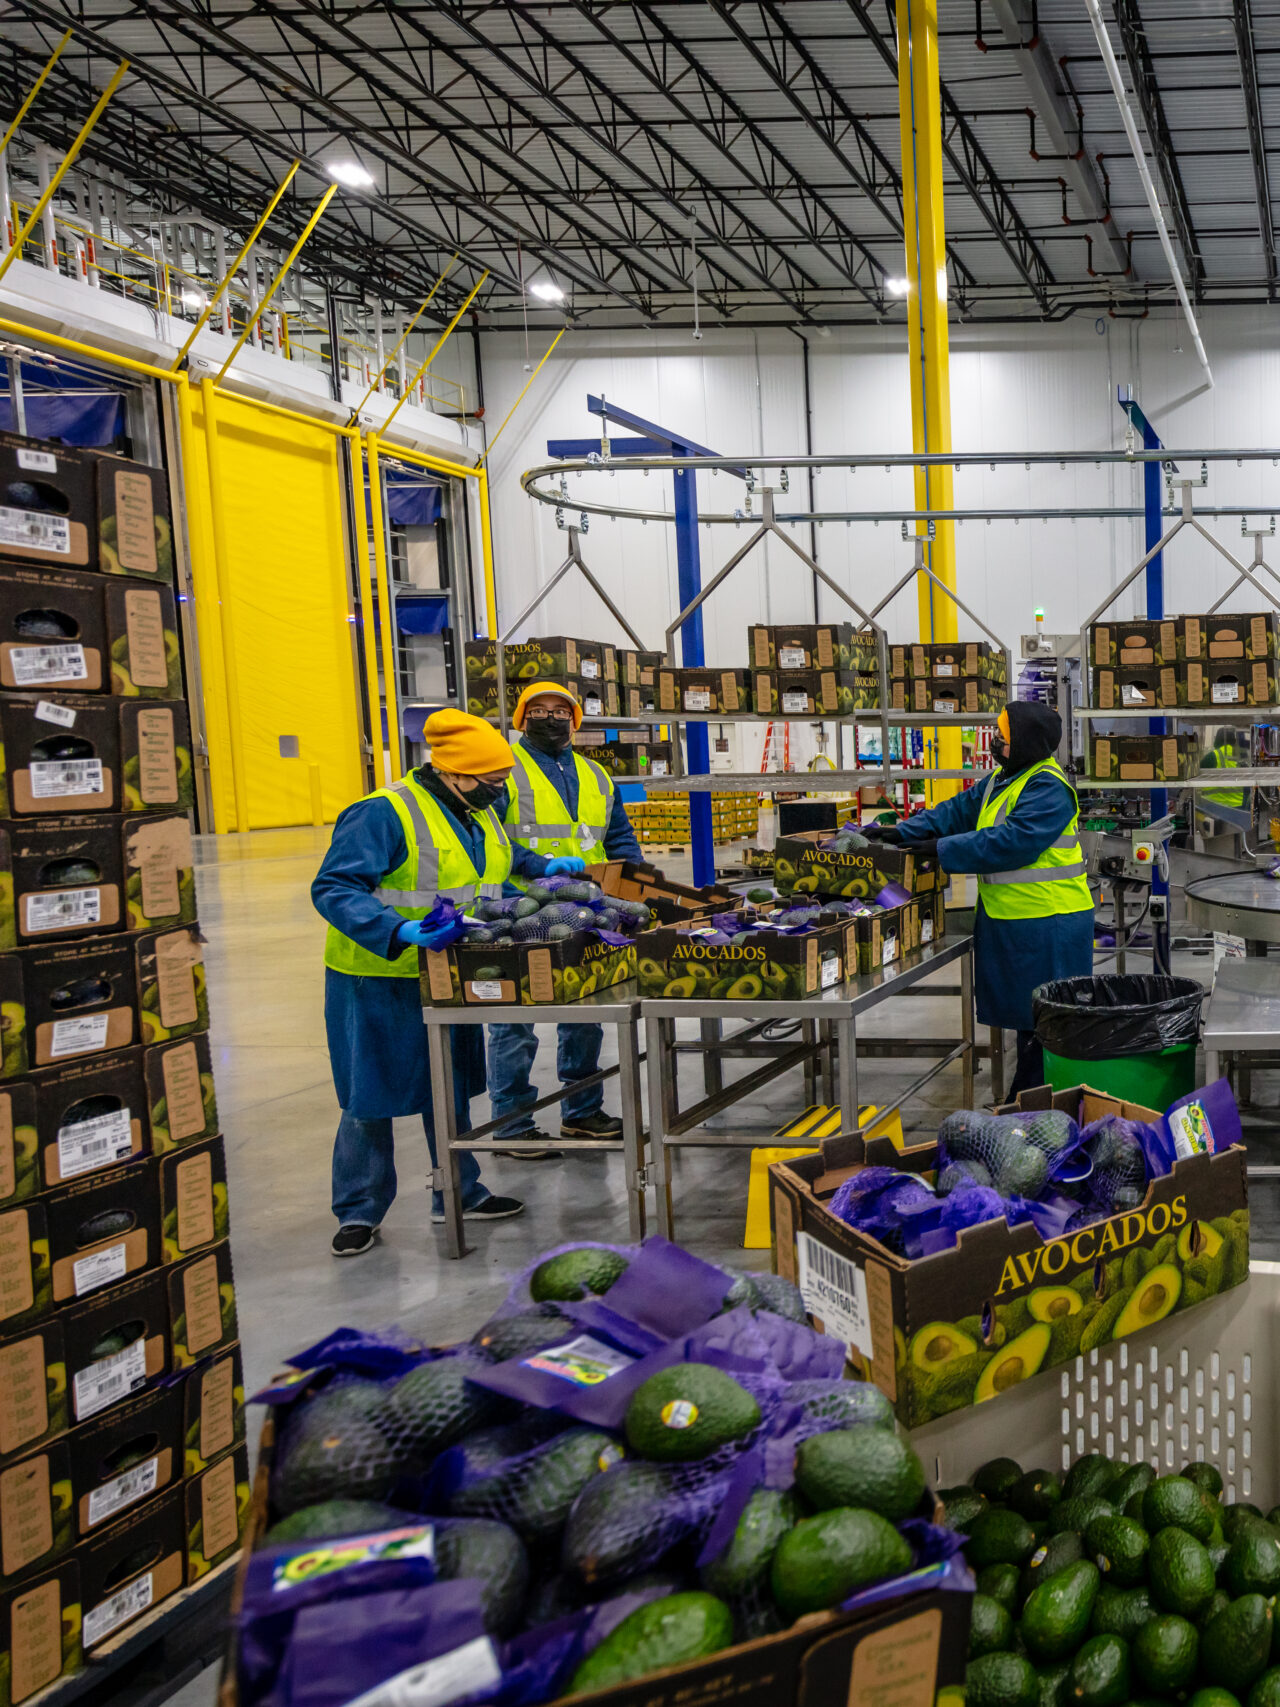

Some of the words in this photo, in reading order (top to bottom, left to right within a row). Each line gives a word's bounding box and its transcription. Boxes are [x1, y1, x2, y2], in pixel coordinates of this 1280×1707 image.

[486, 643, 541, 656] AVCADOS
[802, 849, 874, 868] AVOCADOS
[672, 944, 767, 961] AVOCADOS
[994, 1194, 1187, 1296] AVOCADOS
